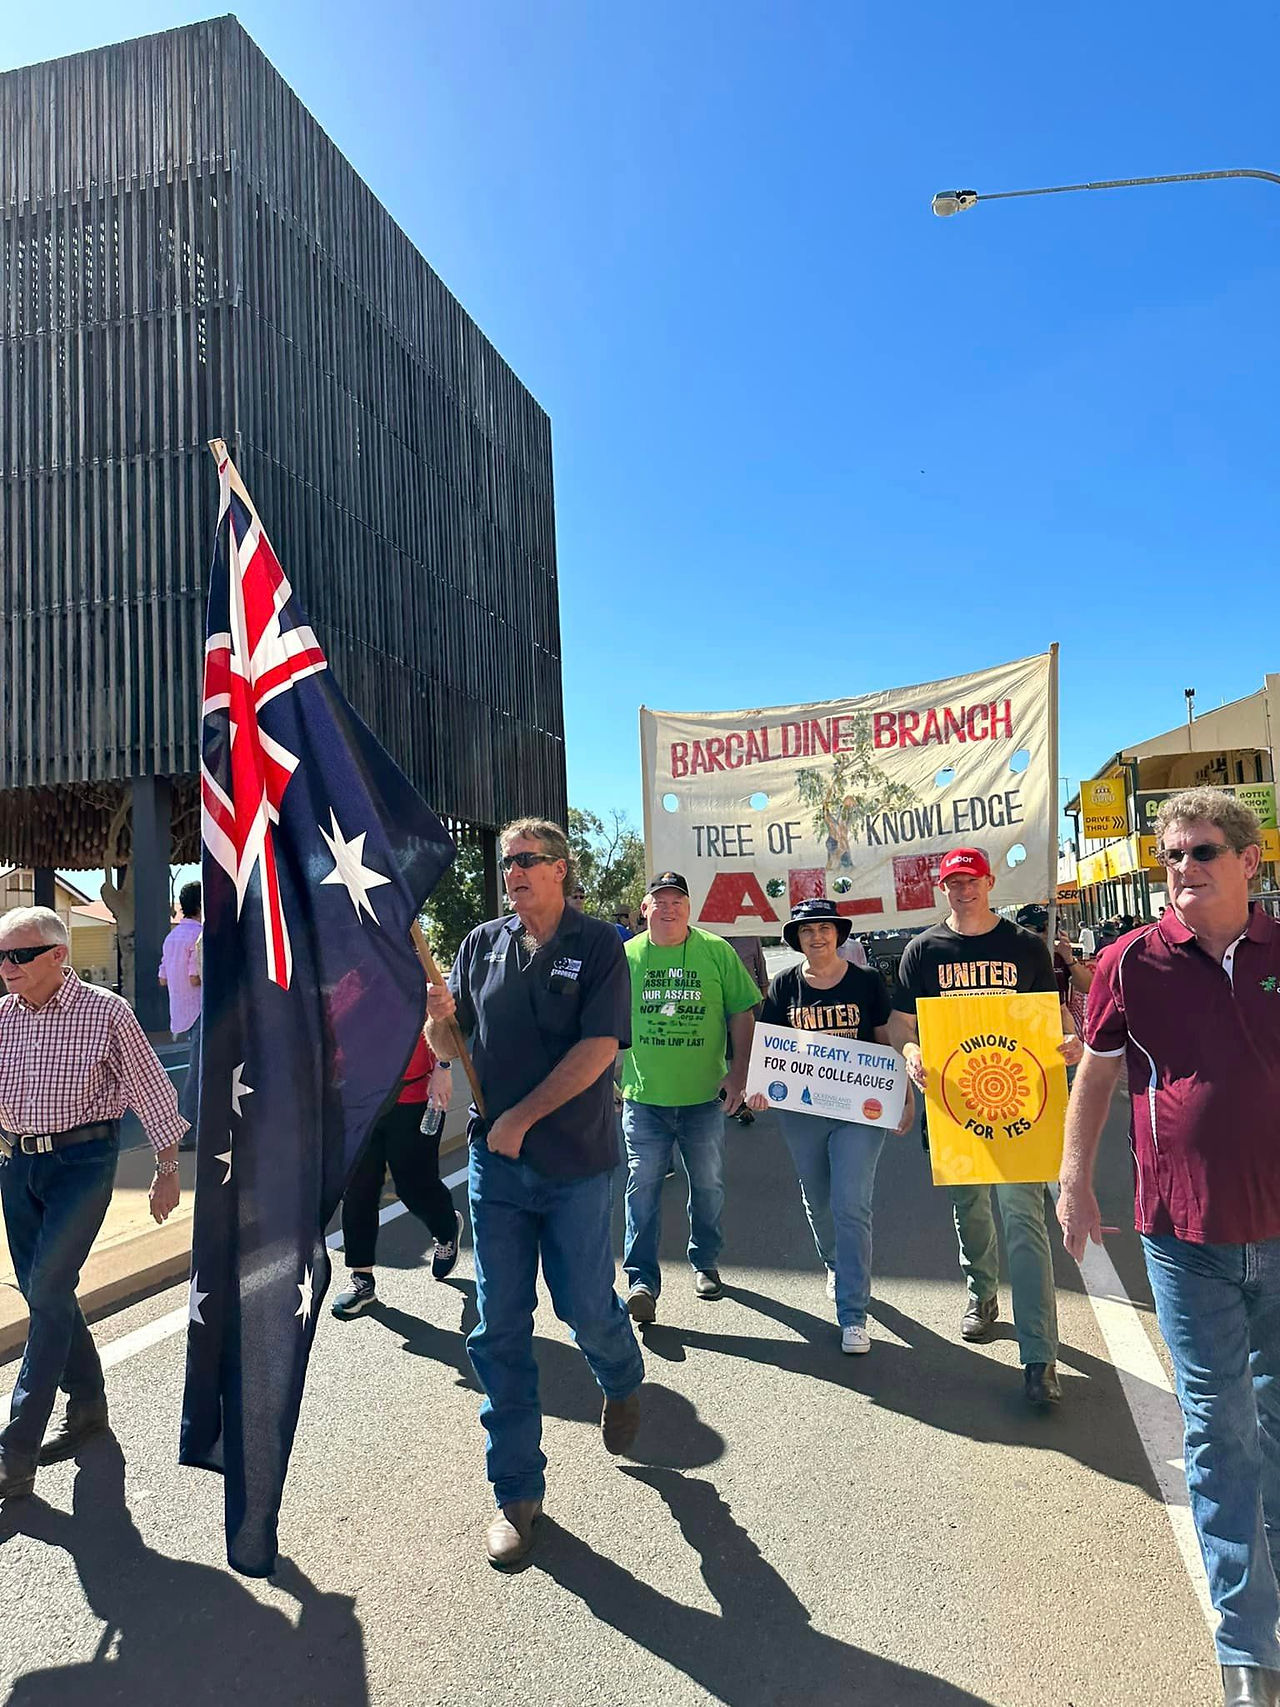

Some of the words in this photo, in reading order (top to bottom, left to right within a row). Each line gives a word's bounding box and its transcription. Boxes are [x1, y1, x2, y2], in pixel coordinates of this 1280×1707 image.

[671, 715, 855, 778] BARCALDINE
[873, 698, 1013, 749] BRANCH
[1239, 790, 1271, 798] BOTTLE
[692, 823, 755, 857] TREE
[767, 821, 802, 855] OF
[865, 789, 1025, 846] KNOWLEDGE
[946, 856, 973, 867] Labor
[650, 970, 666, 978] SAY
[668, 968, 683, 978] NO
[686, 970, 698, 978] TO
[938, 961, 1018, 989] UNITED
[645, 979, 671, 988] ASSET
[675, 979, 701, 988] SALES
[642, 990, 661, 1000] OUR
[664, 989, 702, 1000] ASSETS
[787, 1003, 860, 1029] UNITED
[651, 1036, 666, 1046] The
[668, 1037, 684, 1047] LNP
[686, 1037, 705, 1047] LAST
[960, 1034, 1018, 1053] UNIONS
[764, 1036, 800, 1054] VOICE.
[806, 1044, 852, 1063] TREATY.
[858, 1053, 898, 1072] TRUTH.
[764, 1057, 786, 1072] FOR
[791, 1061, 814, 1077] OUR
[818, 1066, 894, 1091] COLLEAGUES
[964, 1118, 994, 1139] FOR
[1003, 1117, 1032, 1139] YES
